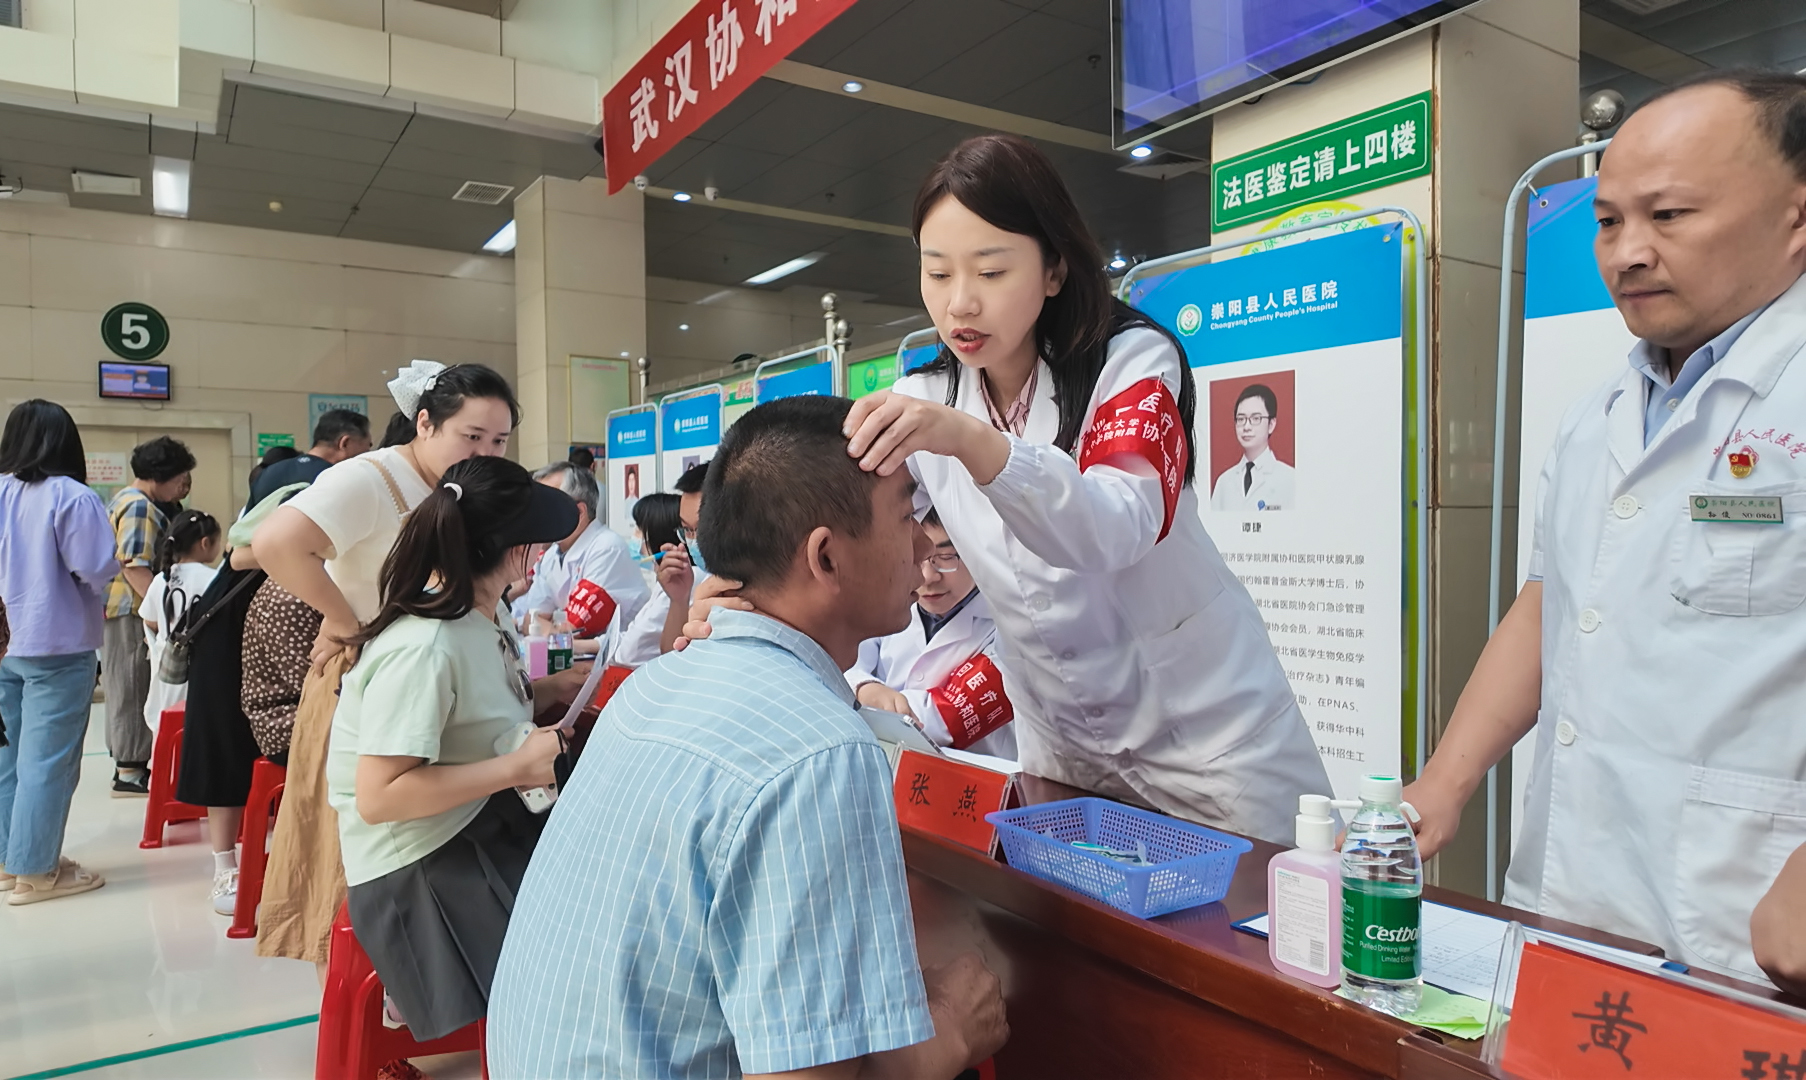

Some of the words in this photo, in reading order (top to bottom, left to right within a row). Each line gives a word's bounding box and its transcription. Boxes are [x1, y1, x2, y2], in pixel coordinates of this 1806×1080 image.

[1222, 120, 1416, 210] 法医鉴定请上四楼
[1210, 316, 1248, 330] Chongyang
[1248, 313, 1274, 324] County
[1274, 307, 1305, 319] People's
[1306, 300, 1338, 313] Hospital
[1211, 280, 1338, 320] 崇阳县人民医院
[121, 313, 151, 350] 5
[1242, 522, 1262, 533] 谭捷
